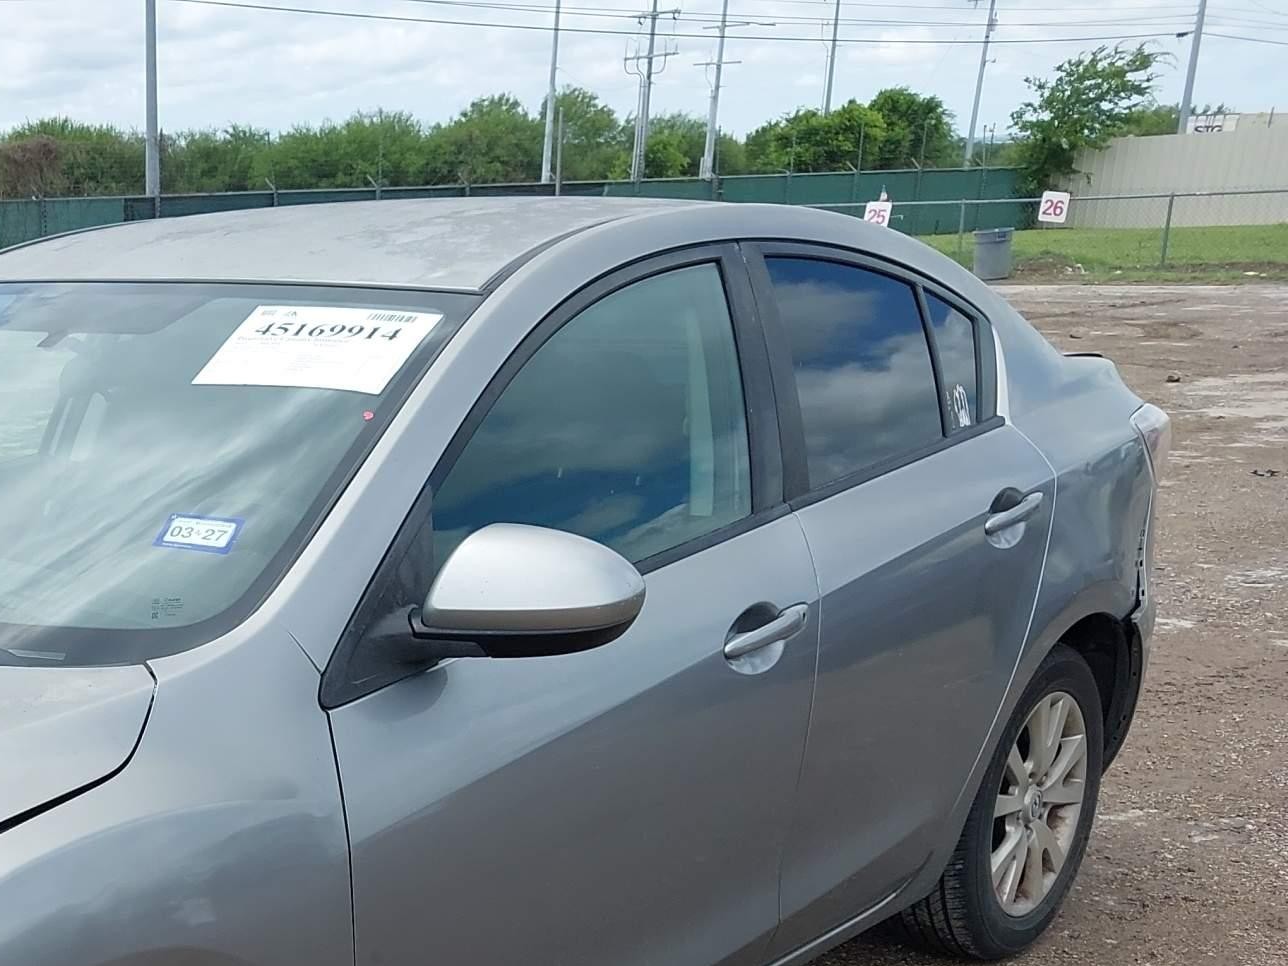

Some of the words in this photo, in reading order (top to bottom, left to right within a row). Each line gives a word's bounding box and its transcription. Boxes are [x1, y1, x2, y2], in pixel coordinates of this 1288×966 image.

[867, 208, 887, 225] 25
[1042, 199, 1065, 217] 26
[255, 321, 403, 341] 45169914
[170, 525, 195, 539] 03
[202, 528, 229, 542] 27
